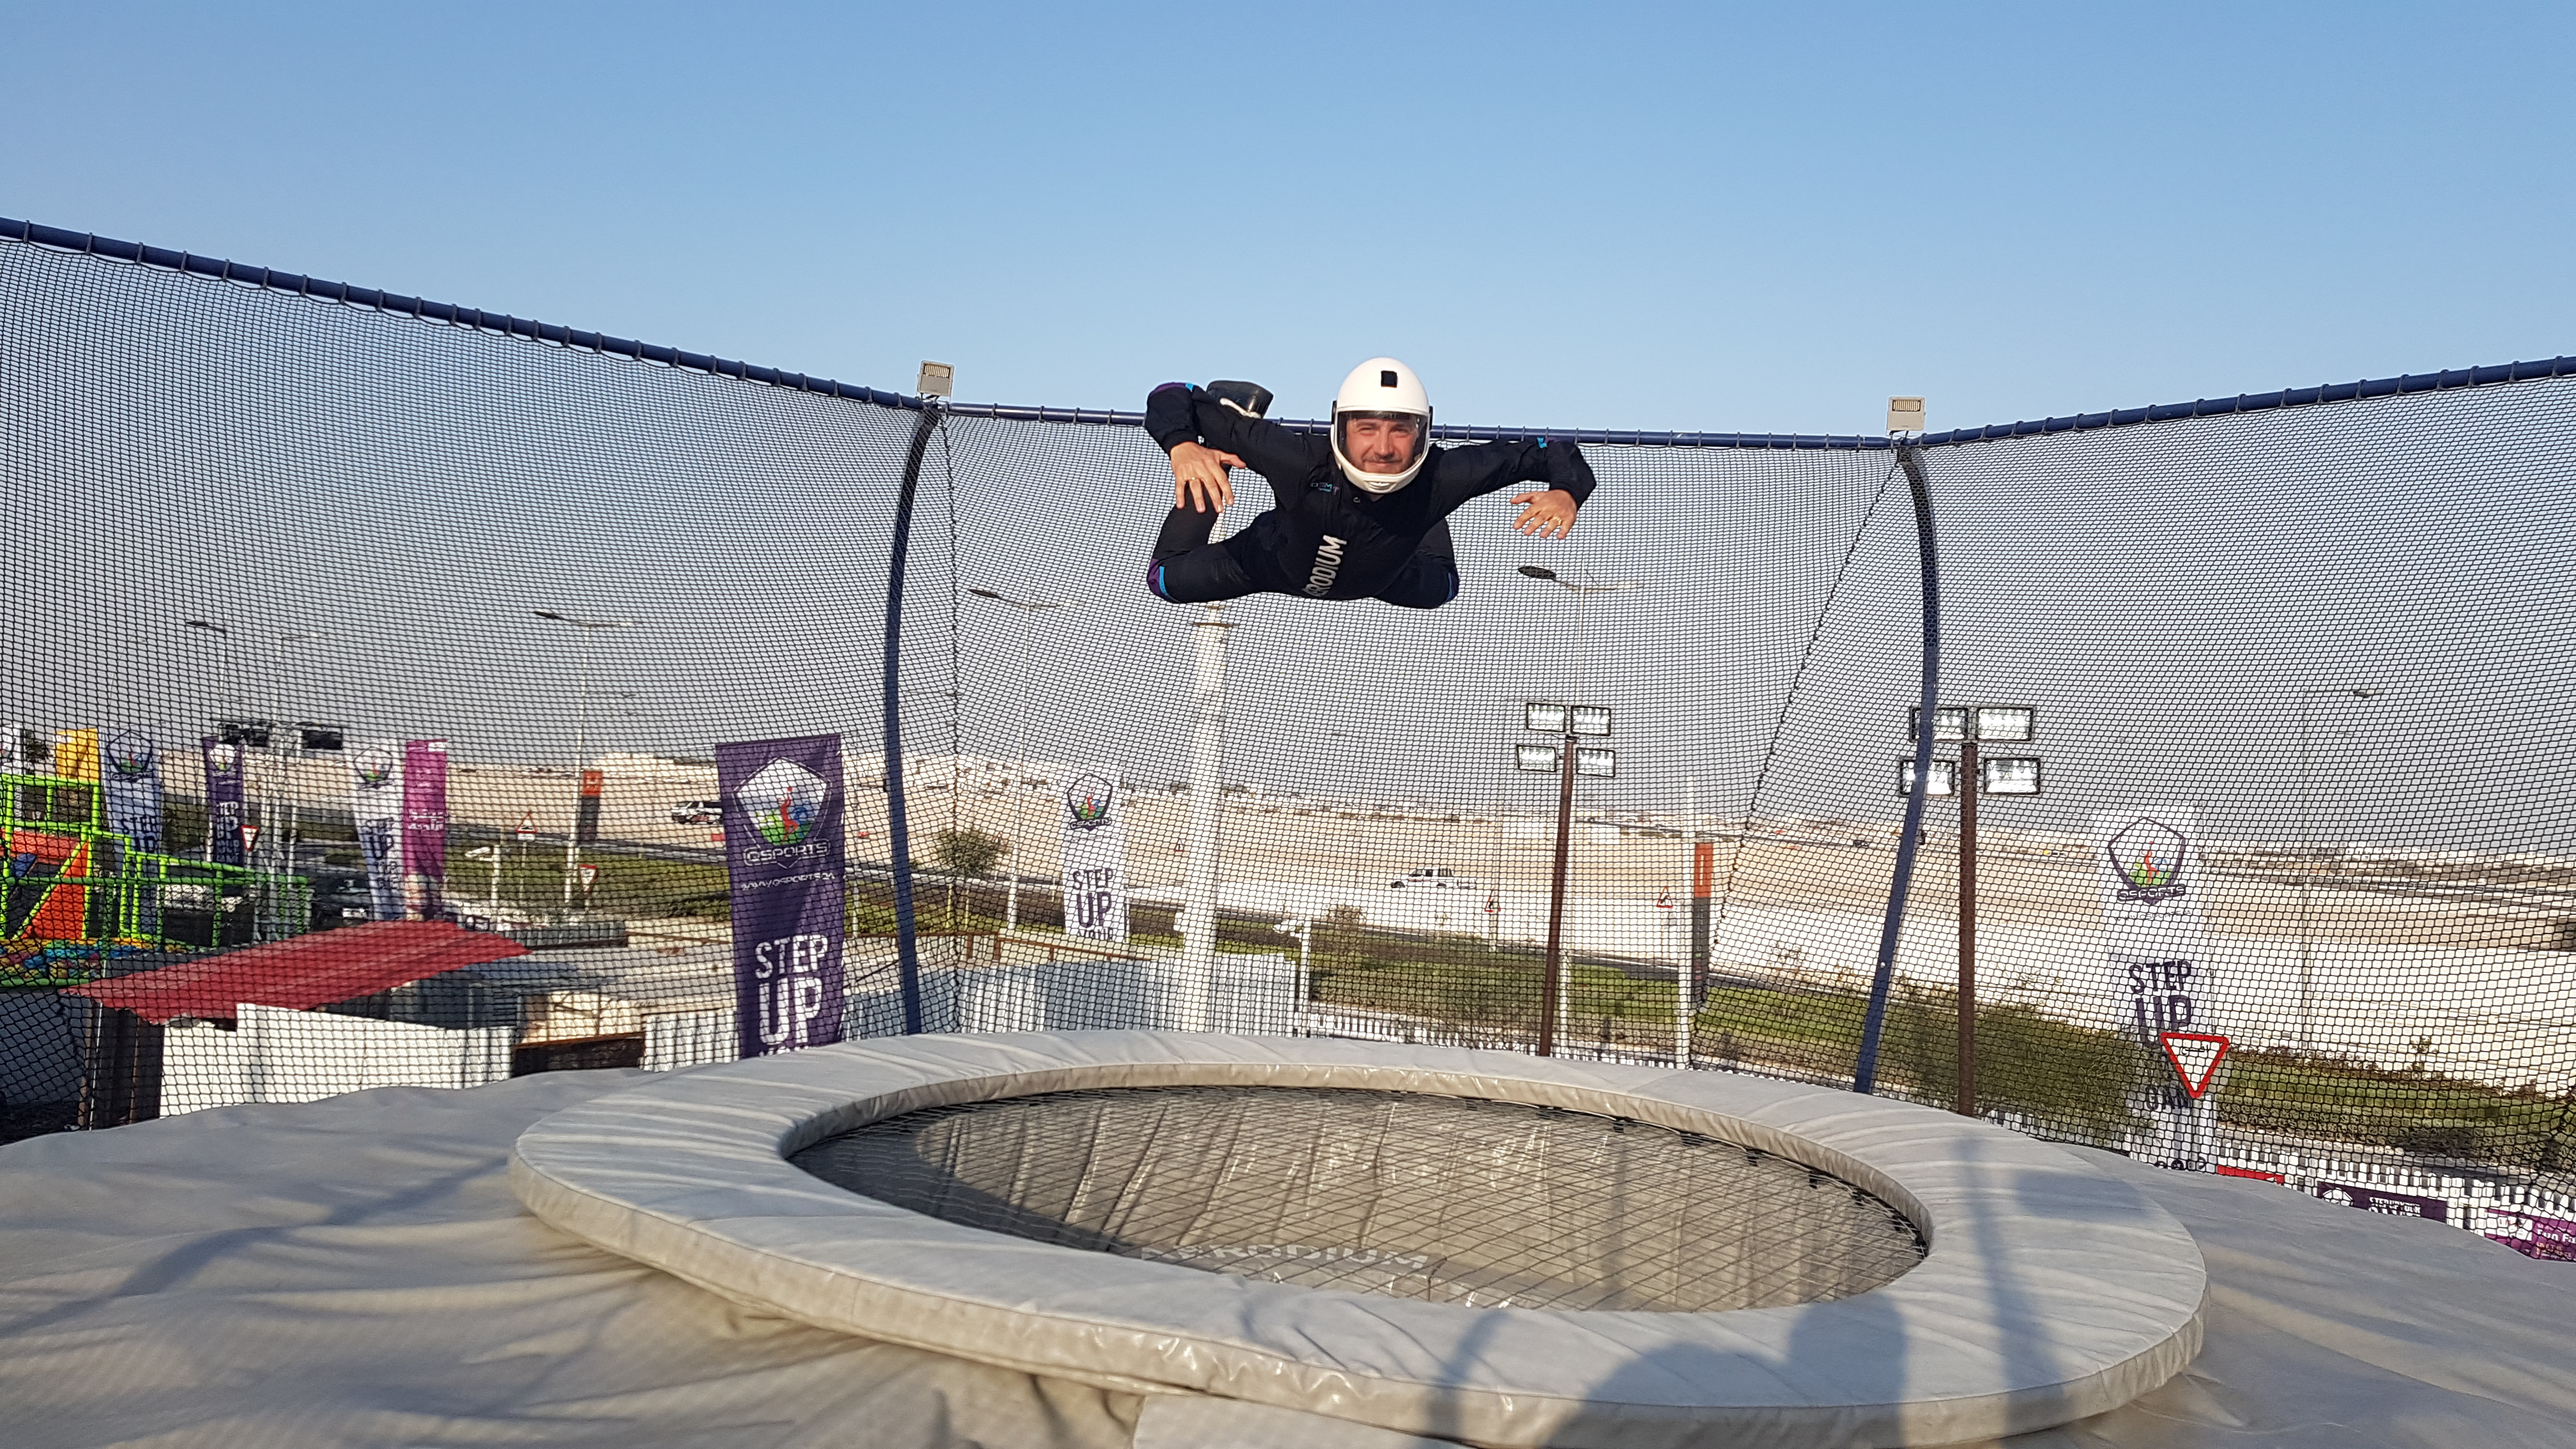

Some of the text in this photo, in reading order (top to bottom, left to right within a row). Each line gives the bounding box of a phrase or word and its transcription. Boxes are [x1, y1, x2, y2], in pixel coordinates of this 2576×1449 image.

[747, 842, 828, 862] QSPORTS
[1073, 868, 1114, 890] STEP
[1077, 891, 1112, 928] UP
[755, 934, 829, 979] STEP
[2128, 959, 2191, 994] STEP
[758, 976, 822, 1045] UP
